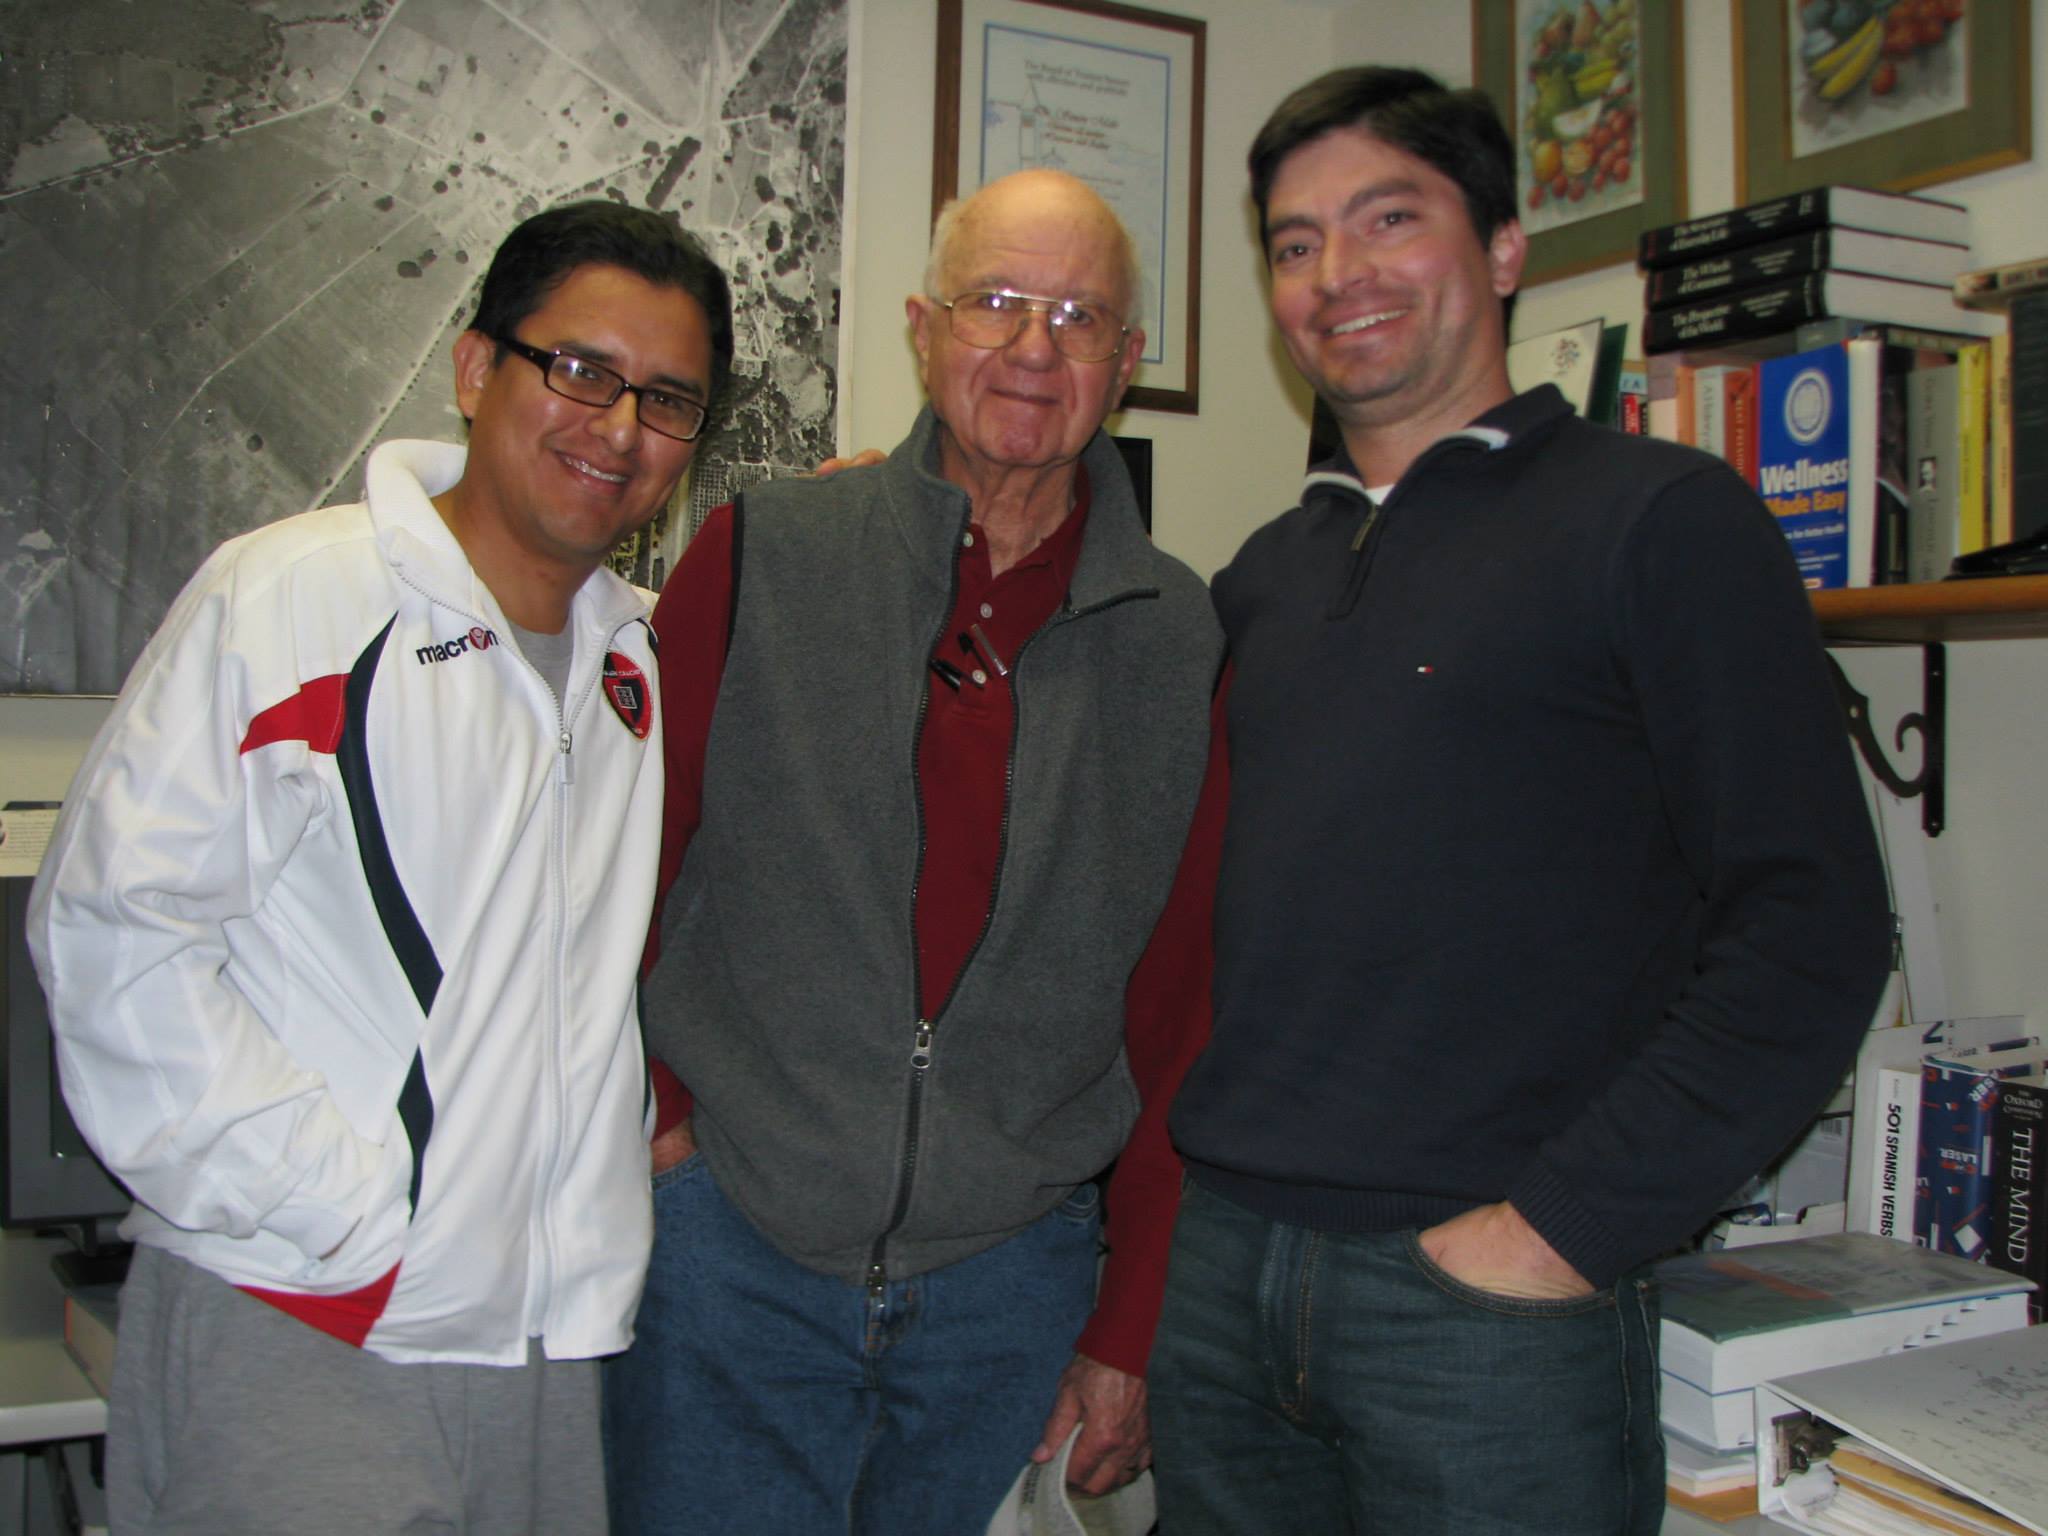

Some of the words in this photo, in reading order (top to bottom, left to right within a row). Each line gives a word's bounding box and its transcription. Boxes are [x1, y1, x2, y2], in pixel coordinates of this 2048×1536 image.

[1760, 458, 1848, 496] Wellness
[1813, 490, 1846, 515] Easy
[416, 627, 499, 666] macron
[1886, 1102, 1902, 1138] 501
[1882, 1136, 1900, 1191] SPANISH
[1940, 1147, 1978, 1165] LASER
[2010, 1127, 2033, 1181] THE
[1879, 1194, 1896, 1238] VERBS
[2007, 1186, 2030, 1264] MIND
